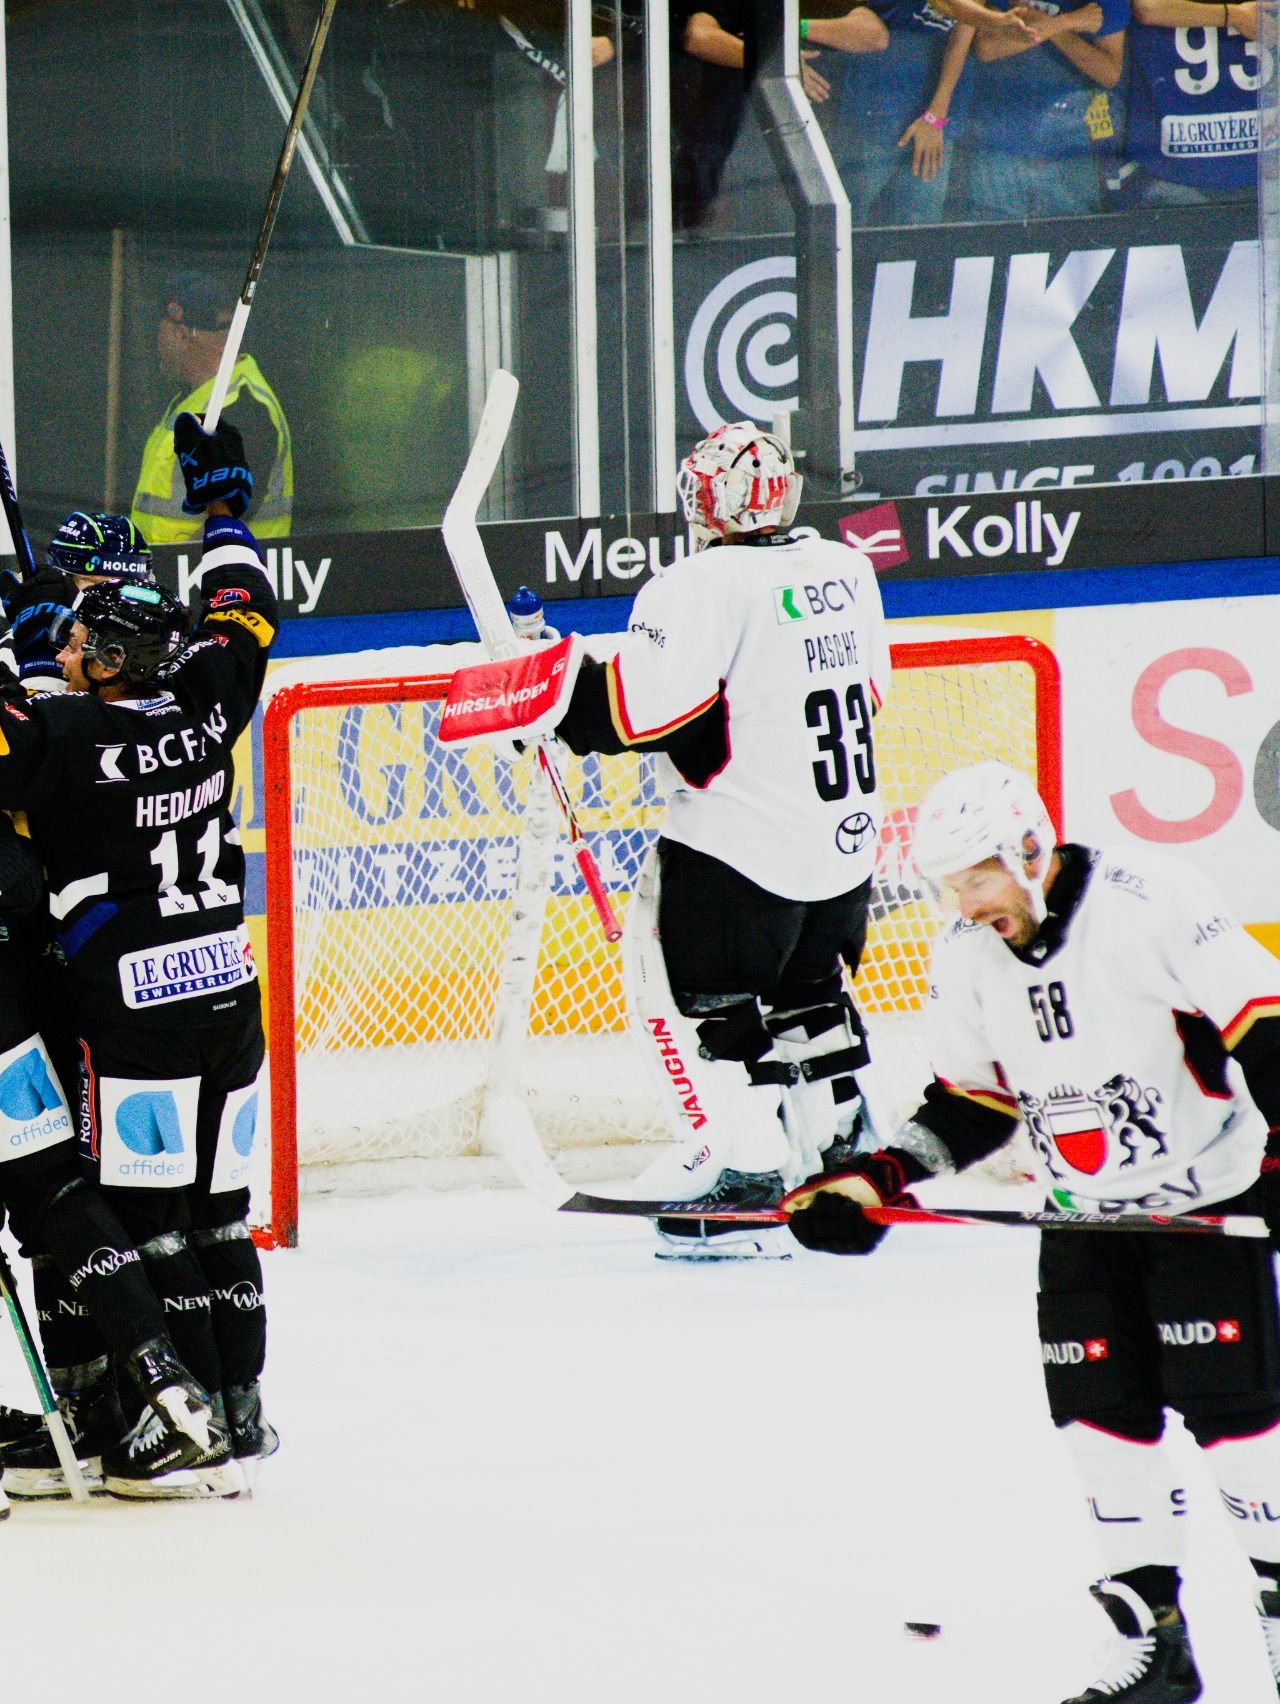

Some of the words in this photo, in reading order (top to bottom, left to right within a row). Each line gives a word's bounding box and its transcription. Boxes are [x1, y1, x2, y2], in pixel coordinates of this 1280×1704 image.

[1170, 121, 1187, 143] LE
[858, 238, 1265, 423] HKM
[926, 500, 1082, 566] Kolly
[177, 547, 333, 614] Klly
[803, 577, 859, 616] BCV
[804, 630, 859, 674] PASCHE
[443, 678, 550, 719] HIRSLANDEN
[804, 682, 877, 802] 33
[135, 769, 226, 828] HEDLUND
[150, 817, 242, 918] 11
[129, 957, 159, 988] LE
[1027, 980, 1075, 1043] 58
[647, 1017, 708, 1131] VAUGHN
[9, 1114, 69, 1147] affidea
[119, 1160, 185, 1176] affidea
[1038, 1211, 1122, 1224] BAUER
